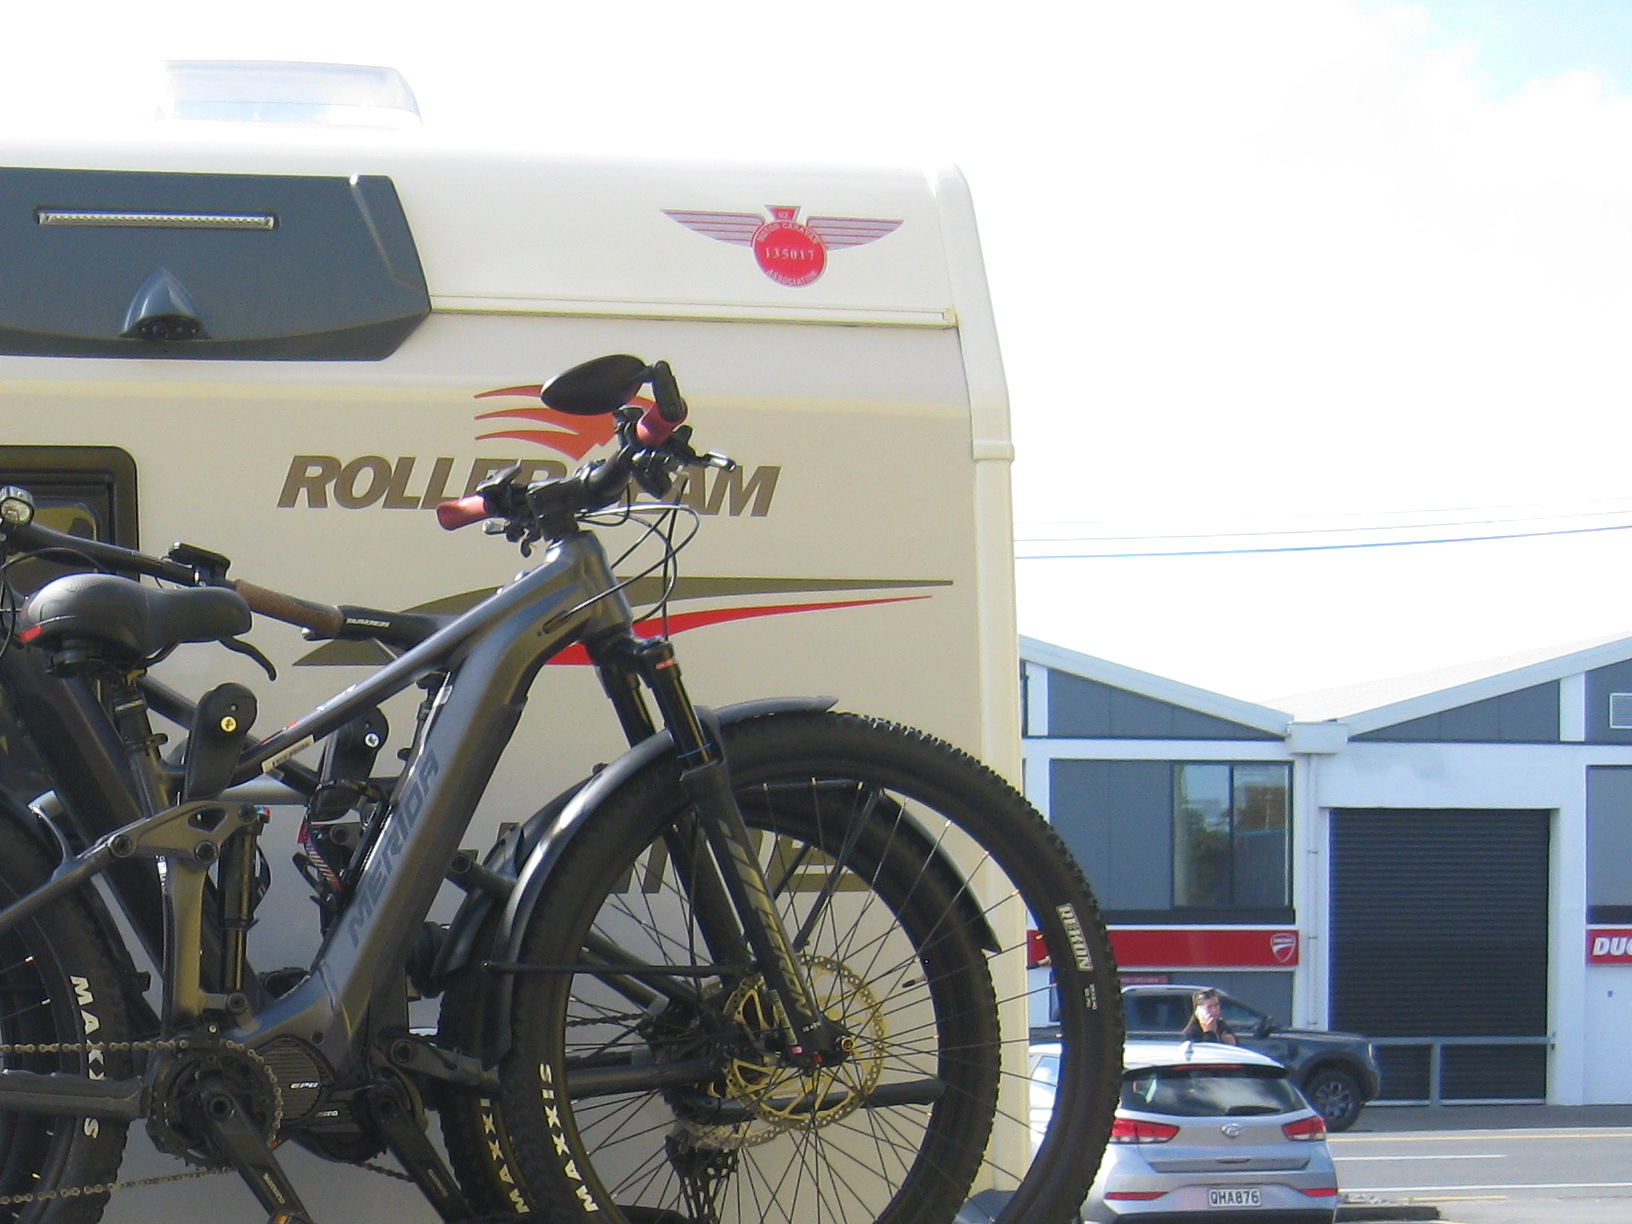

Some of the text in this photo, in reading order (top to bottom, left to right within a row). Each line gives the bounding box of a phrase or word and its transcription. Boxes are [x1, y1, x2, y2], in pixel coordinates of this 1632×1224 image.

[765, 247, 815, 260] 135017
[347, 749, 440, 948] MERIDA
[70, 975, 105, 1139] MAXXS
[480, 1098, 530, 1213] MAXXI
[539, 1063, 599, 1212] MAXXIS
[1210, 1190, 1260, 1204] QHA876
